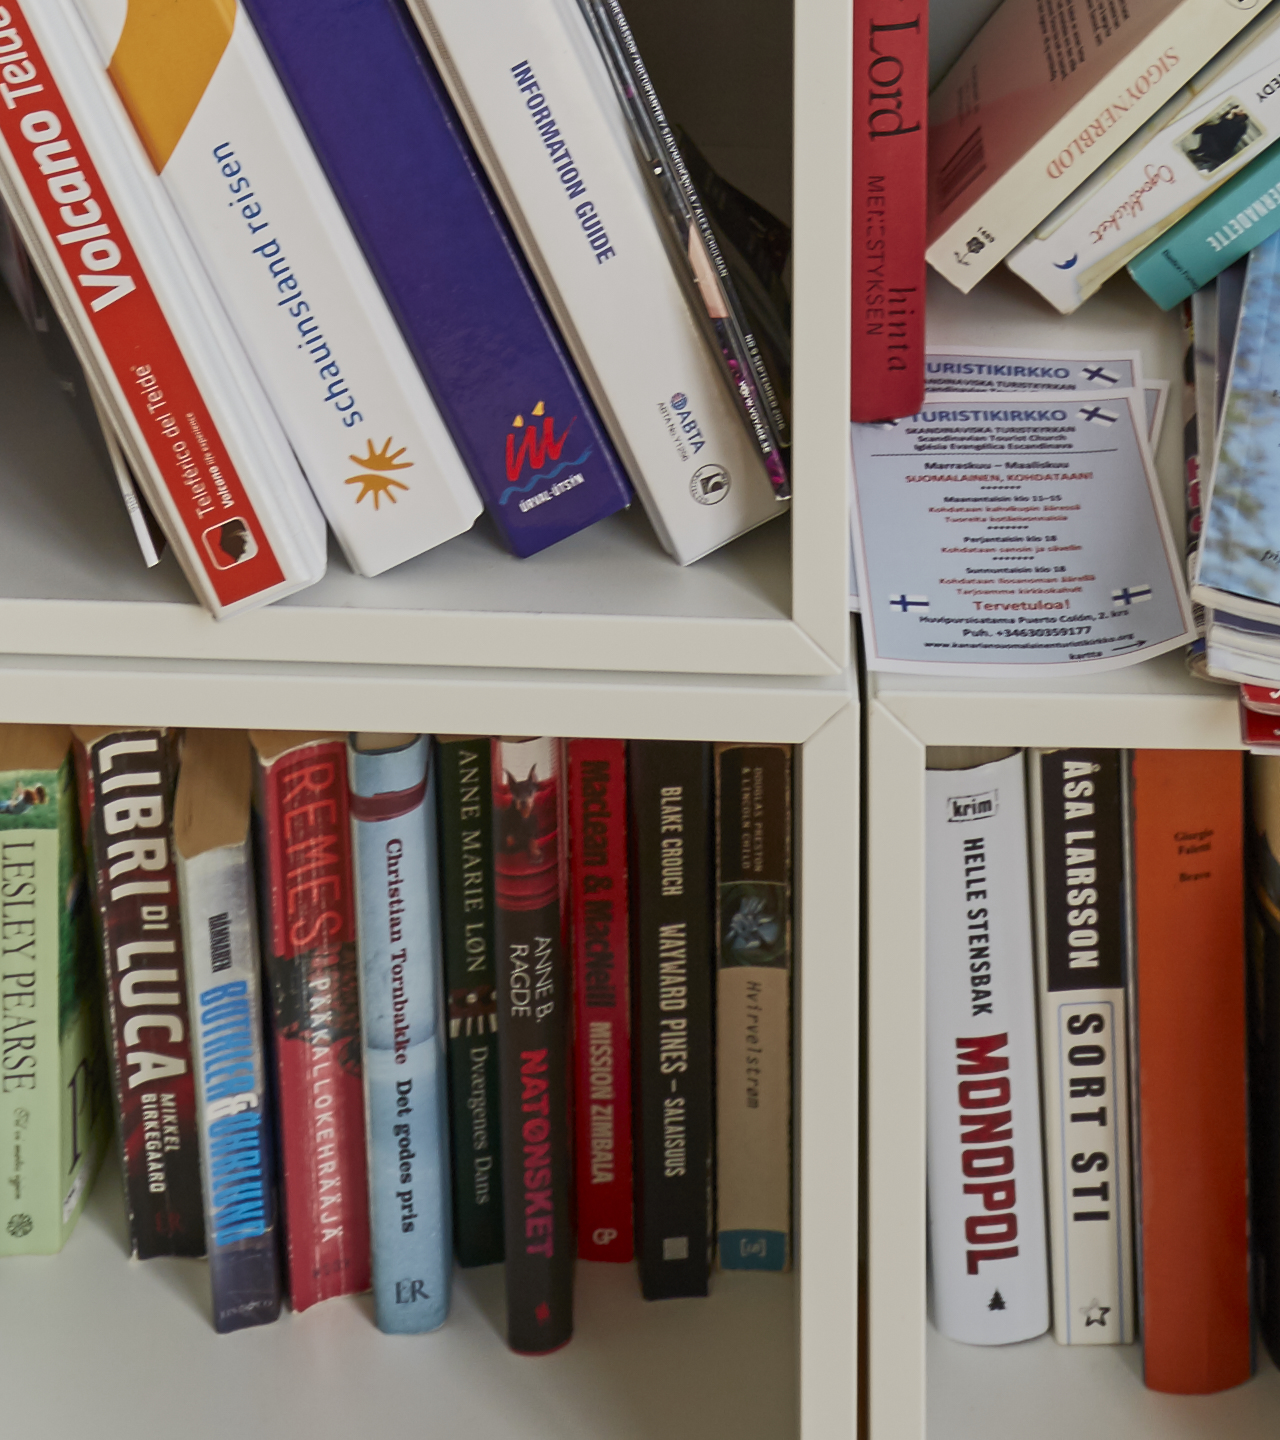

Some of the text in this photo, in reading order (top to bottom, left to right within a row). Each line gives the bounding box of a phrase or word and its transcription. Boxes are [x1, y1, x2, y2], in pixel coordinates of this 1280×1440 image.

[510, 59, 616, 265] INFORMATION GUIDE
[867, 20, 922, 139] Lord
[20, 108, 139, 314] Volcano
[213, 139, 365, 430] schauinsland reisen
[677, 401, 709, 457] ABTA
[912, 410, 1067, 422] TURISTIKIRKKO
[973, 600, 1070, 611] Tervetuloa!
[1, 841, 36, 959] LESLEY
[98, 738, 187, 1089] LIBRI DI LUCA
[963, 838, 994, 1017] HELLE STENSBAK
[1063, 760, 1100, 970] ÅSA LARSSON
[2, 970, 36, 1095] PEARSE
[385, 838, 415, 1234] Christian Tornbakke Det godes pris
[1067, 1012, 1111, 1222] SORT STI
[520, 1049, 555, 1259] NATØNSKET
[955, 1031, 1019, 1276] MONOPOL
